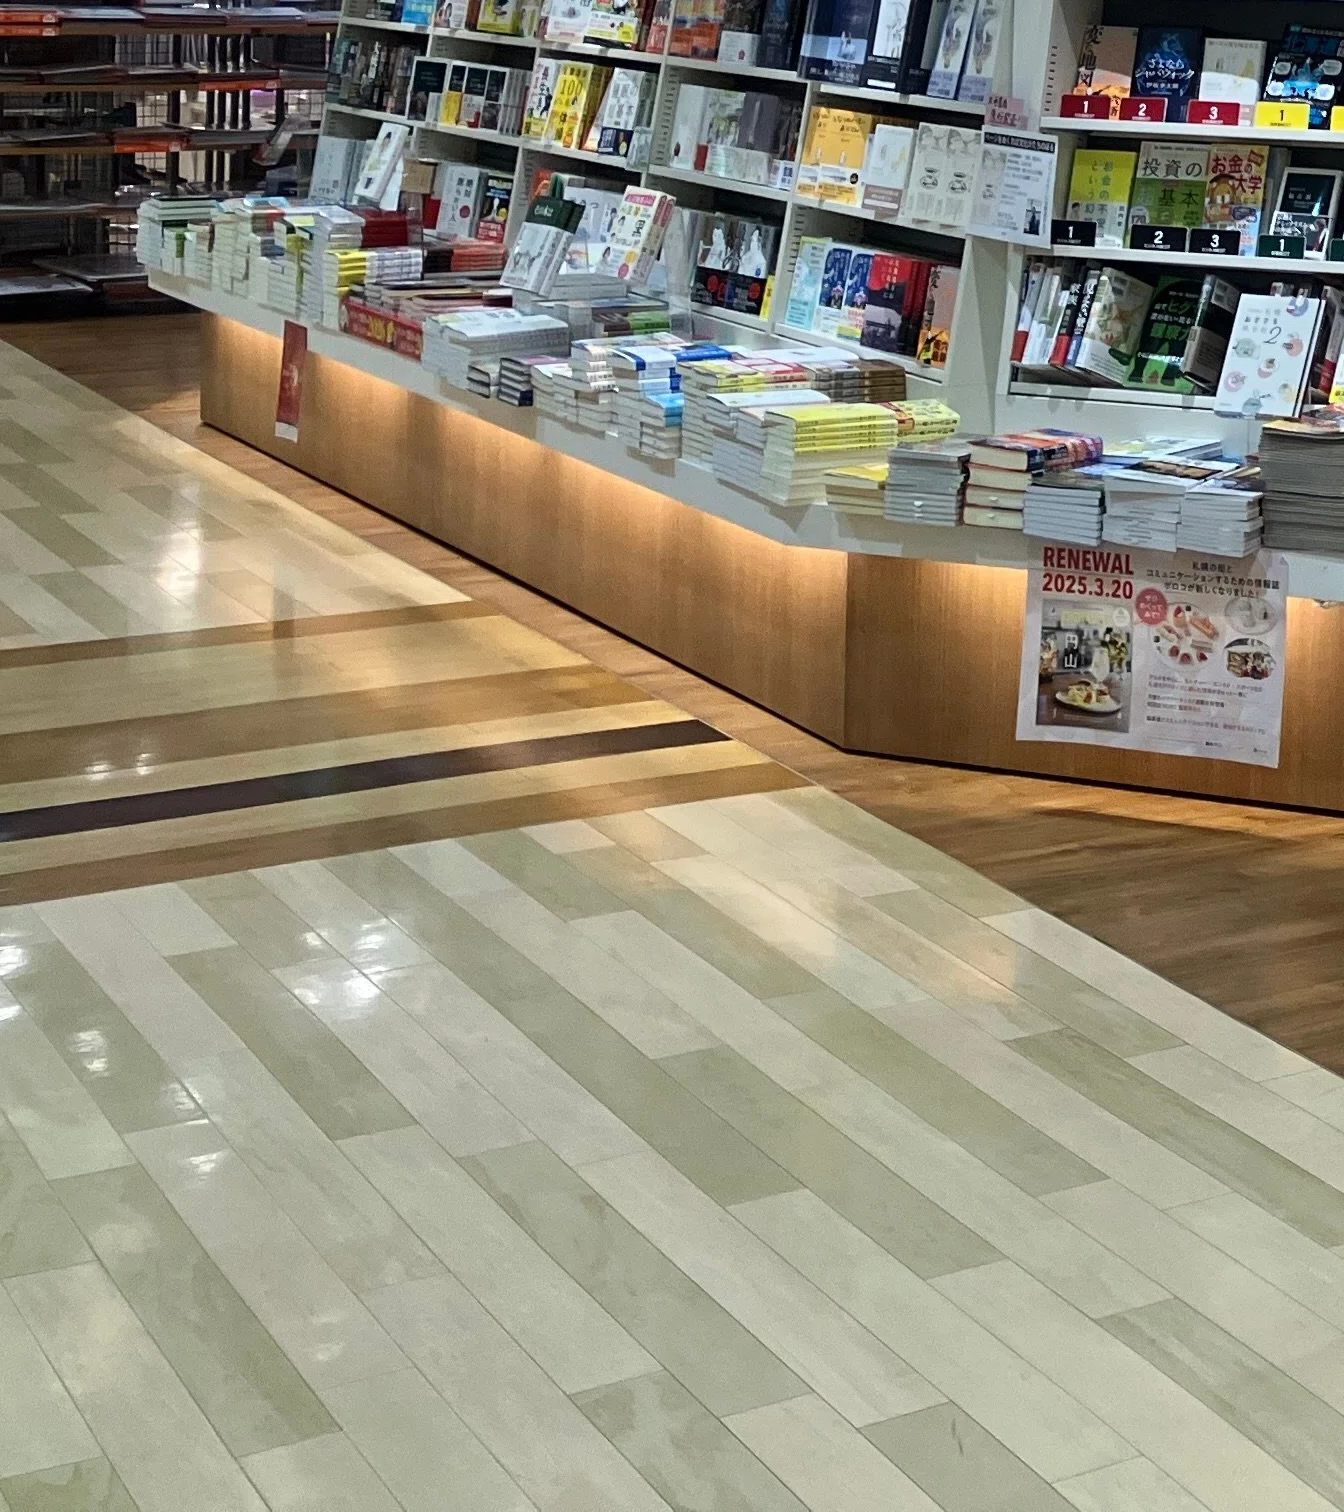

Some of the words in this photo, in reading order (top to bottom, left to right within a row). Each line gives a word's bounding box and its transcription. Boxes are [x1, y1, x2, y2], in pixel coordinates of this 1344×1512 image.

[1083, 100, 1089, 114] 1
[1138, 103, 1147, 116] 2
[1209, 106, 1218, 120] 3
[1279, 109, 1285, 122] 1
[1142, 158, 1203, 179] 投資の
[1159, 188, 1200, 208] 基本
[1067, 226, 1074, 239] 1
[1154, 230, 1164, 244] 2
[1210, 234, 1220, 248] 3
[1279, 239, 1285, 252] 1
[1042, 546, 1135, 577] RENEWAL
[1041, 572, 1134, 600] 2025.3.20
